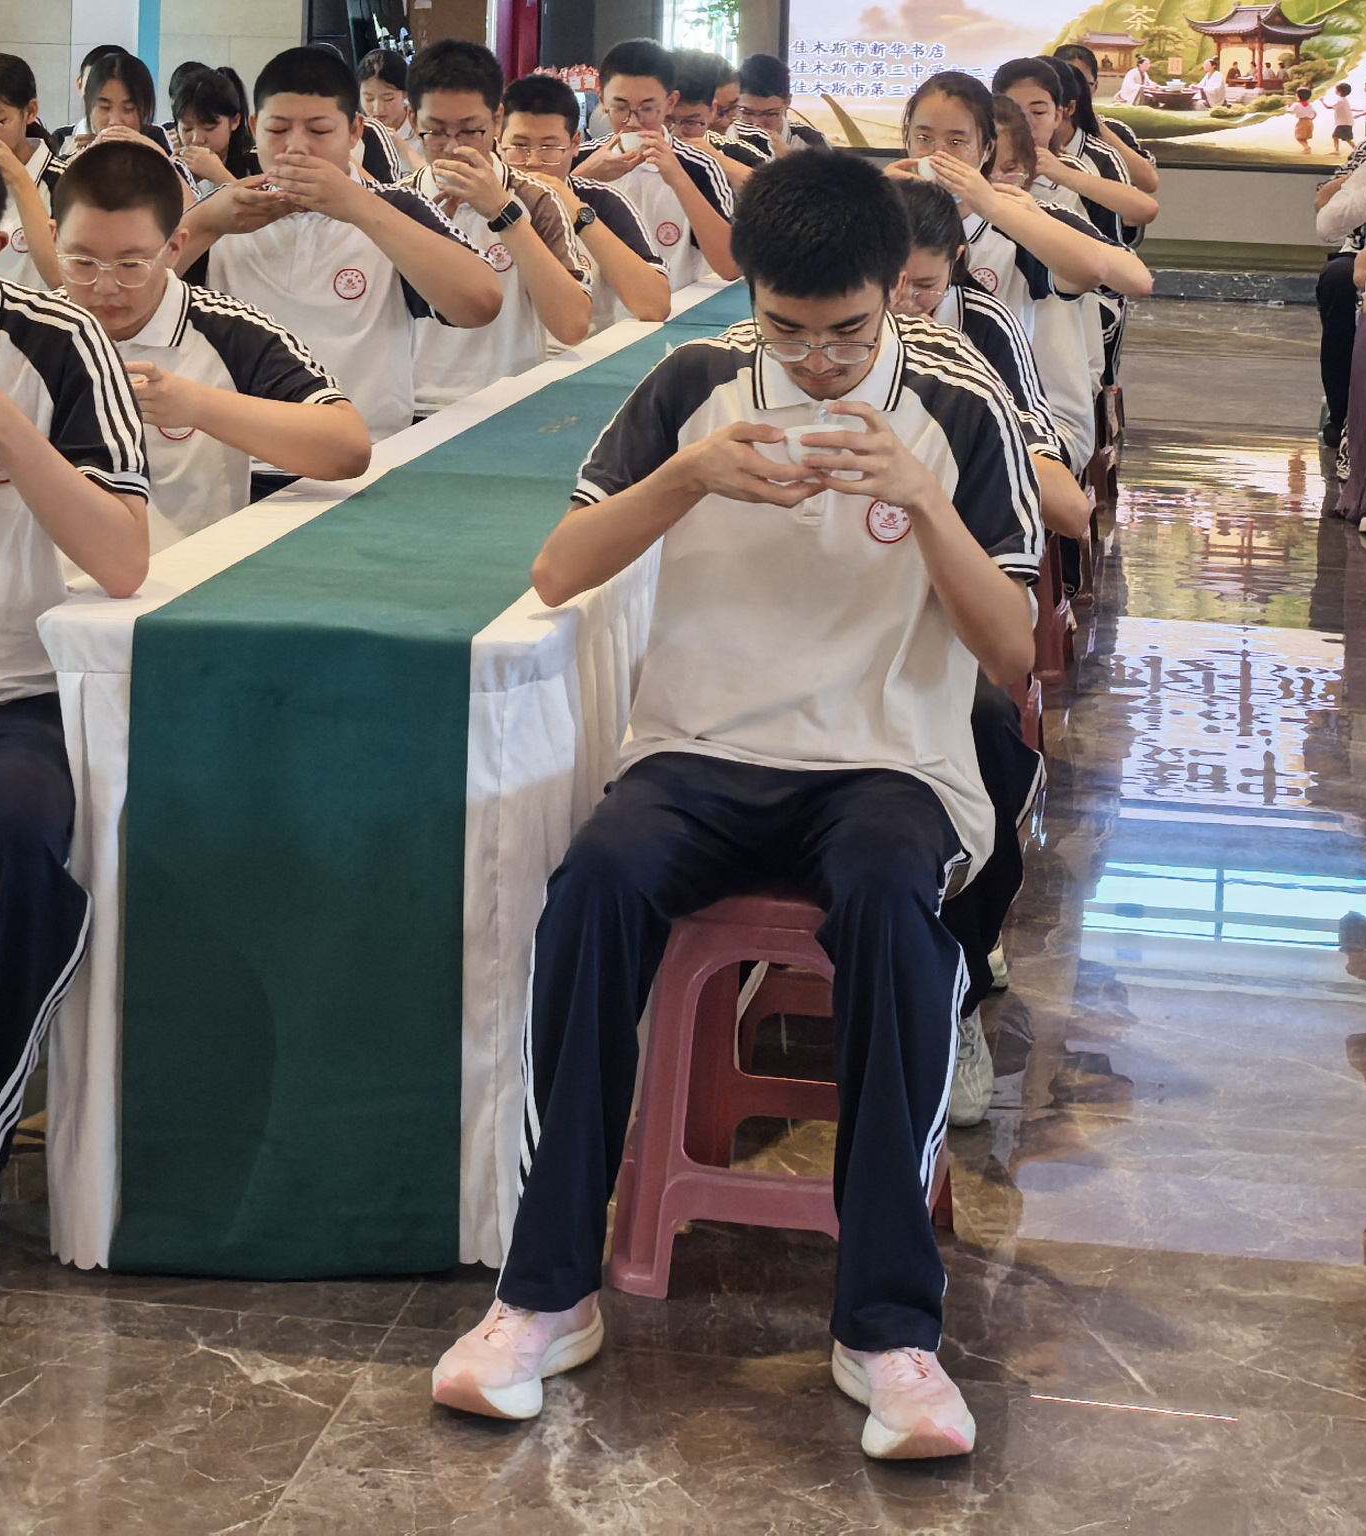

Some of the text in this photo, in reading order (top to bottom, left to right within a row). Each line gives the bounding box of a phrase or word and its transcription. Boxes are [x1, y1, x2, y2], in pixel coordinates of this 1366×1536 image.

[1122, 5, 1157, 32] 茶
[791, 40, 945, 59] 佳木斯市新华书店
